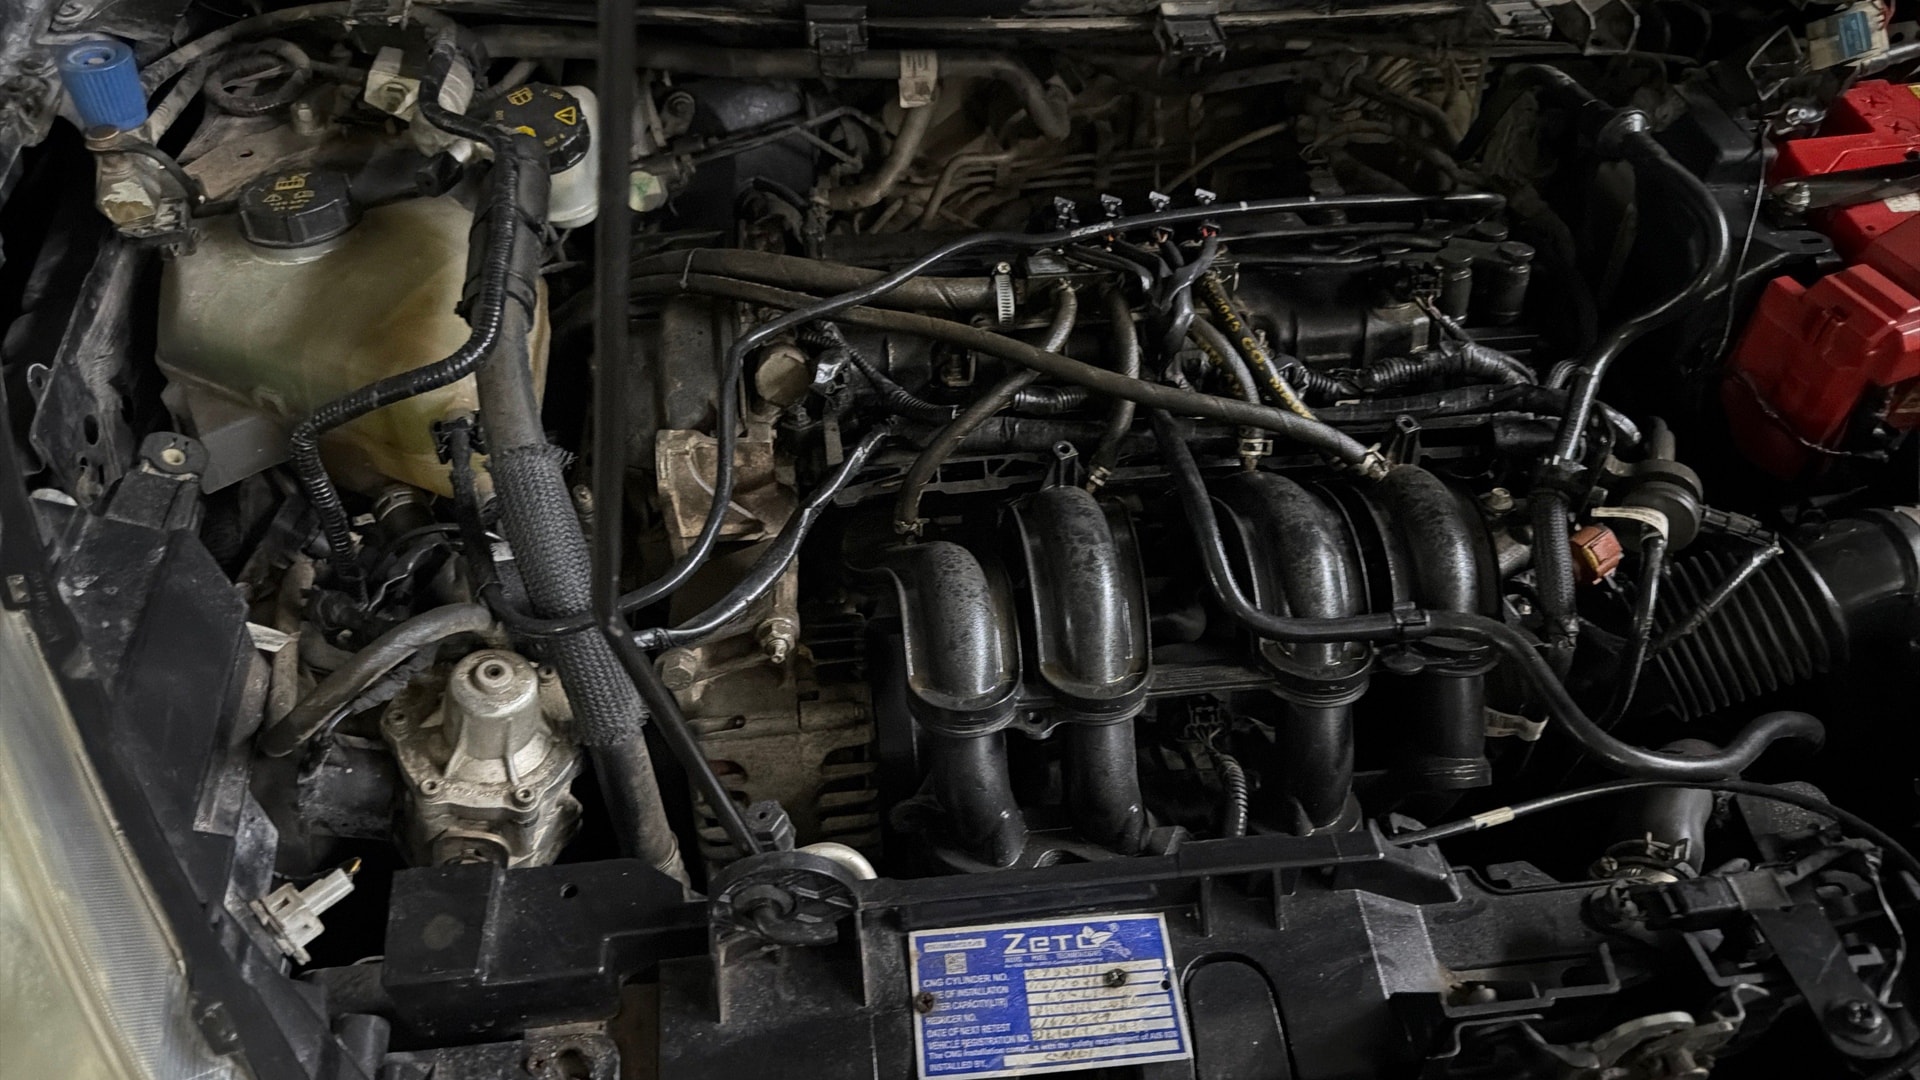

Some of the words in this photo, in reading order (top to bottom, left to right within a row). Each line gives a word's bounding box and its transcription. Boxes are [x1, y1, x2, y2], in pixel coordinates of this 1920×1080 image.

[922, 978, 943, 987] CNG
[945, 973, 991, 985] CYLINDER
[945, 989, 954, 998] OF
[955, 985, 1009, 997] INSTALLATION
[925, 1014, 962, 1025] REDUCER
[926, 1028, 947, 1038] DATE
[947, 1027, 960, 1036] OF
[959, 1025, 980, 1035] NEXT
[981, 1022, 1011, 1033] RETEST
[927, 1039, 960, 1050] VEHICLE
[961, 1034, 1016, 1047] REGISTRATION
[943, 1050, 962, 1058] CNG
[1070, 1038, 1094, 1048] safety
[929, 1060, 972, 1071] INSTALLED
